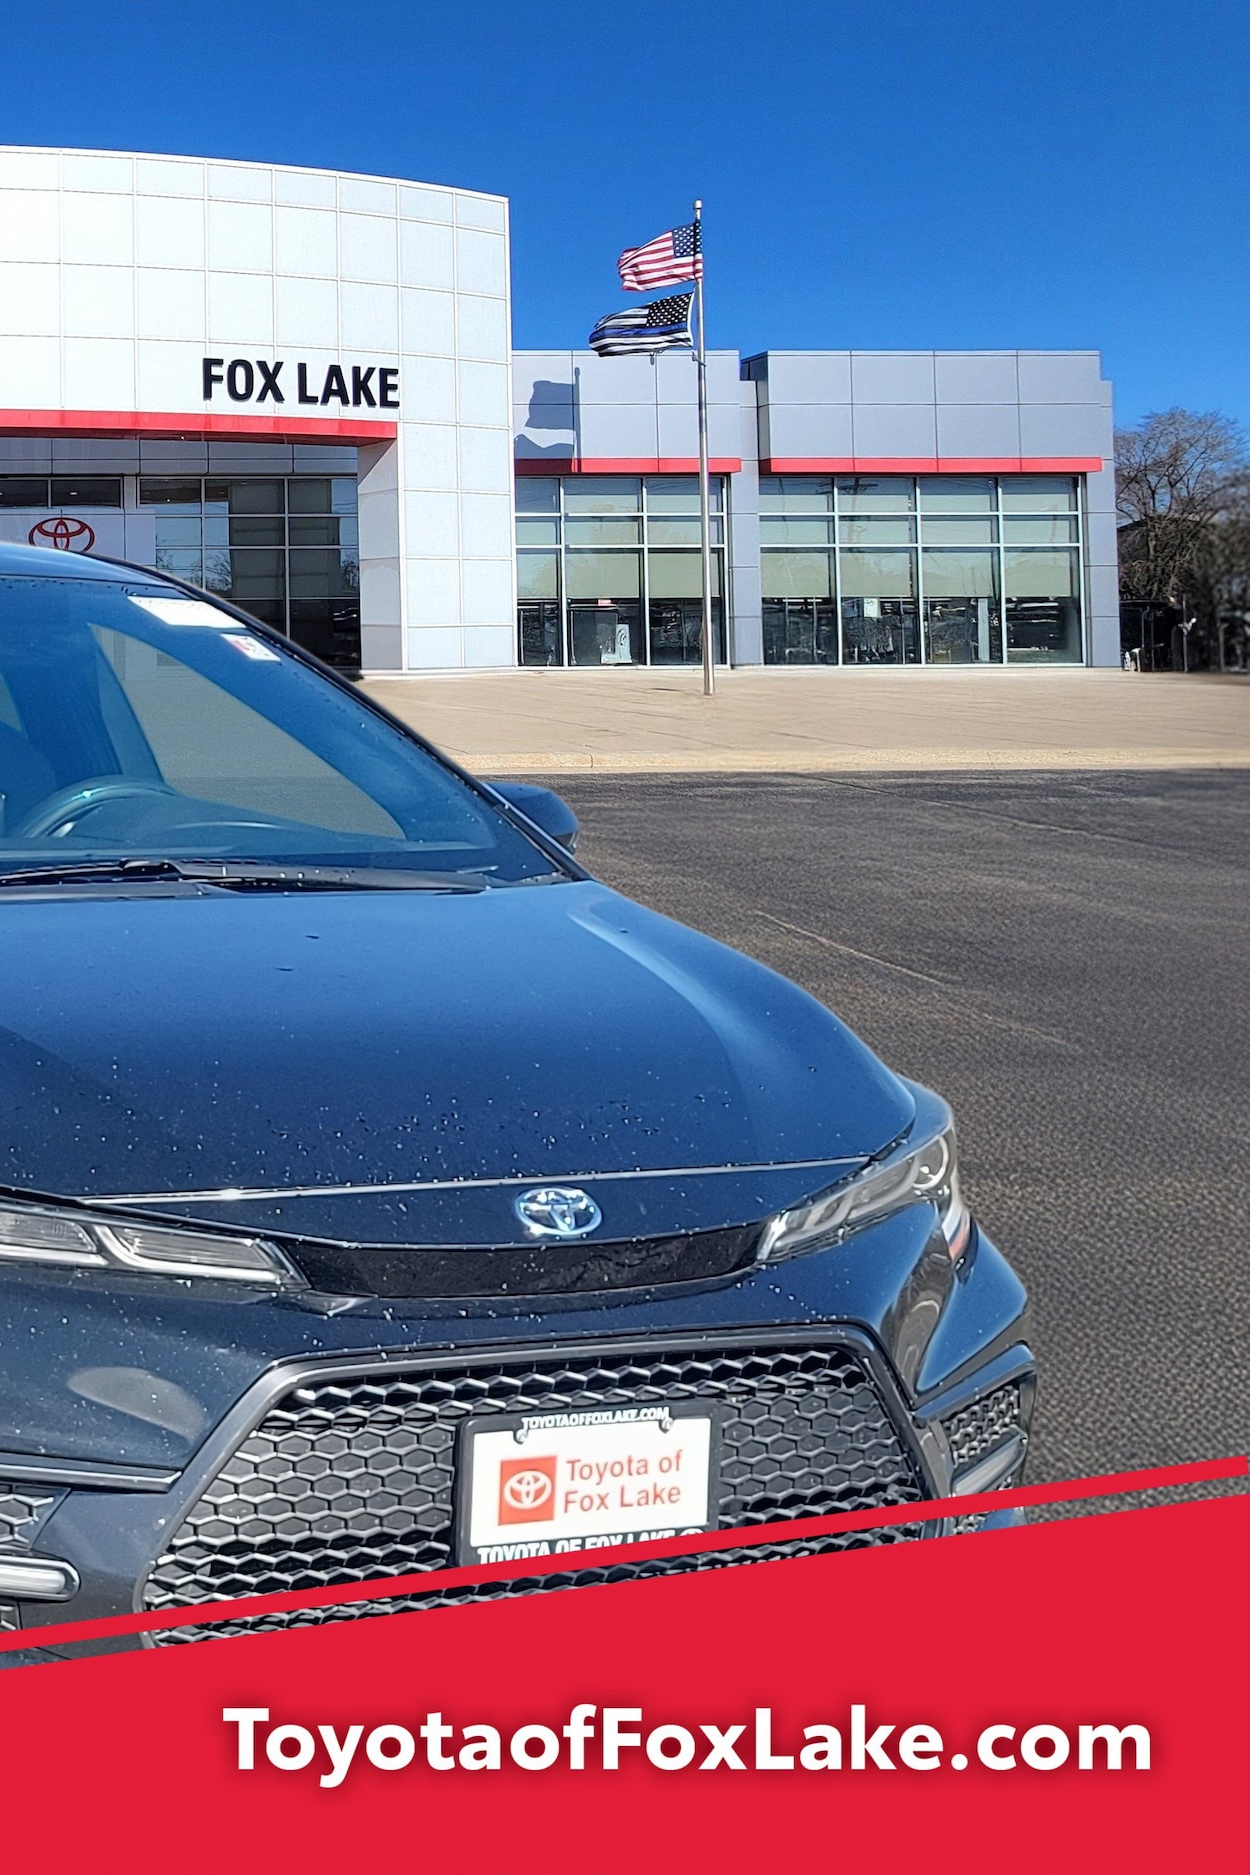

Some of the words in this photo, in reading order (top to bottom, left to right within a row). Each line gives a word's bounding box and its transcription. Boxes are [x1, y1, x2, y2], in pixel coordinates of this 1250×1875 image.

[202, 357, 285, 403] FOX
[297, 362, 401, 408] LAKE
[521, 1407, 670, 1430] TOYOTAOFFOXLAKE.COM
[566, 1454, 649, 1486] Toyota
[658, 1449, 683, 1474] of
[563, 1489, 610, 1514] Fox
[620, 1482, 681, 1508] Lake
[477, 1541, 550, 1565] TOYOTA
